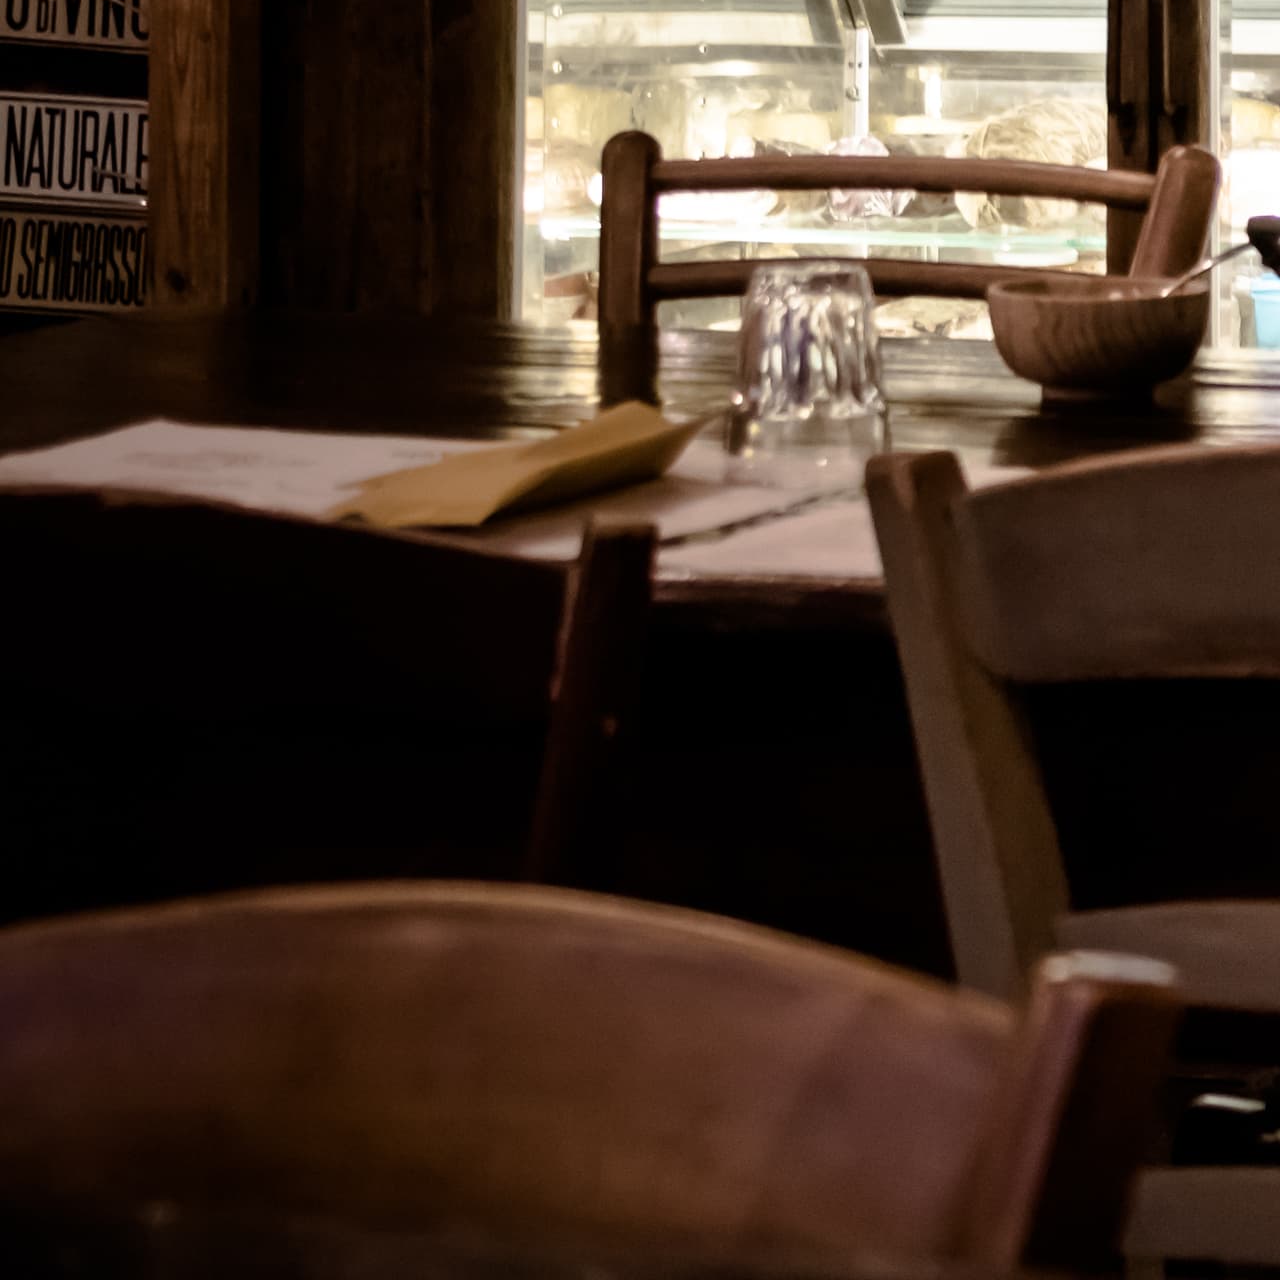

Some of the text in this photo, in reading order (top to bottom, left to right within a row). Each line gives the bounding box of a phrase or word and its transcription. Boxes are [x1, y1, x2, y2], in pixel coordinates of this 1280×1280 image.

[4, 105, 149, 195] NATURALE
[0, 217, 148, 307] O SEMIGRASSO
